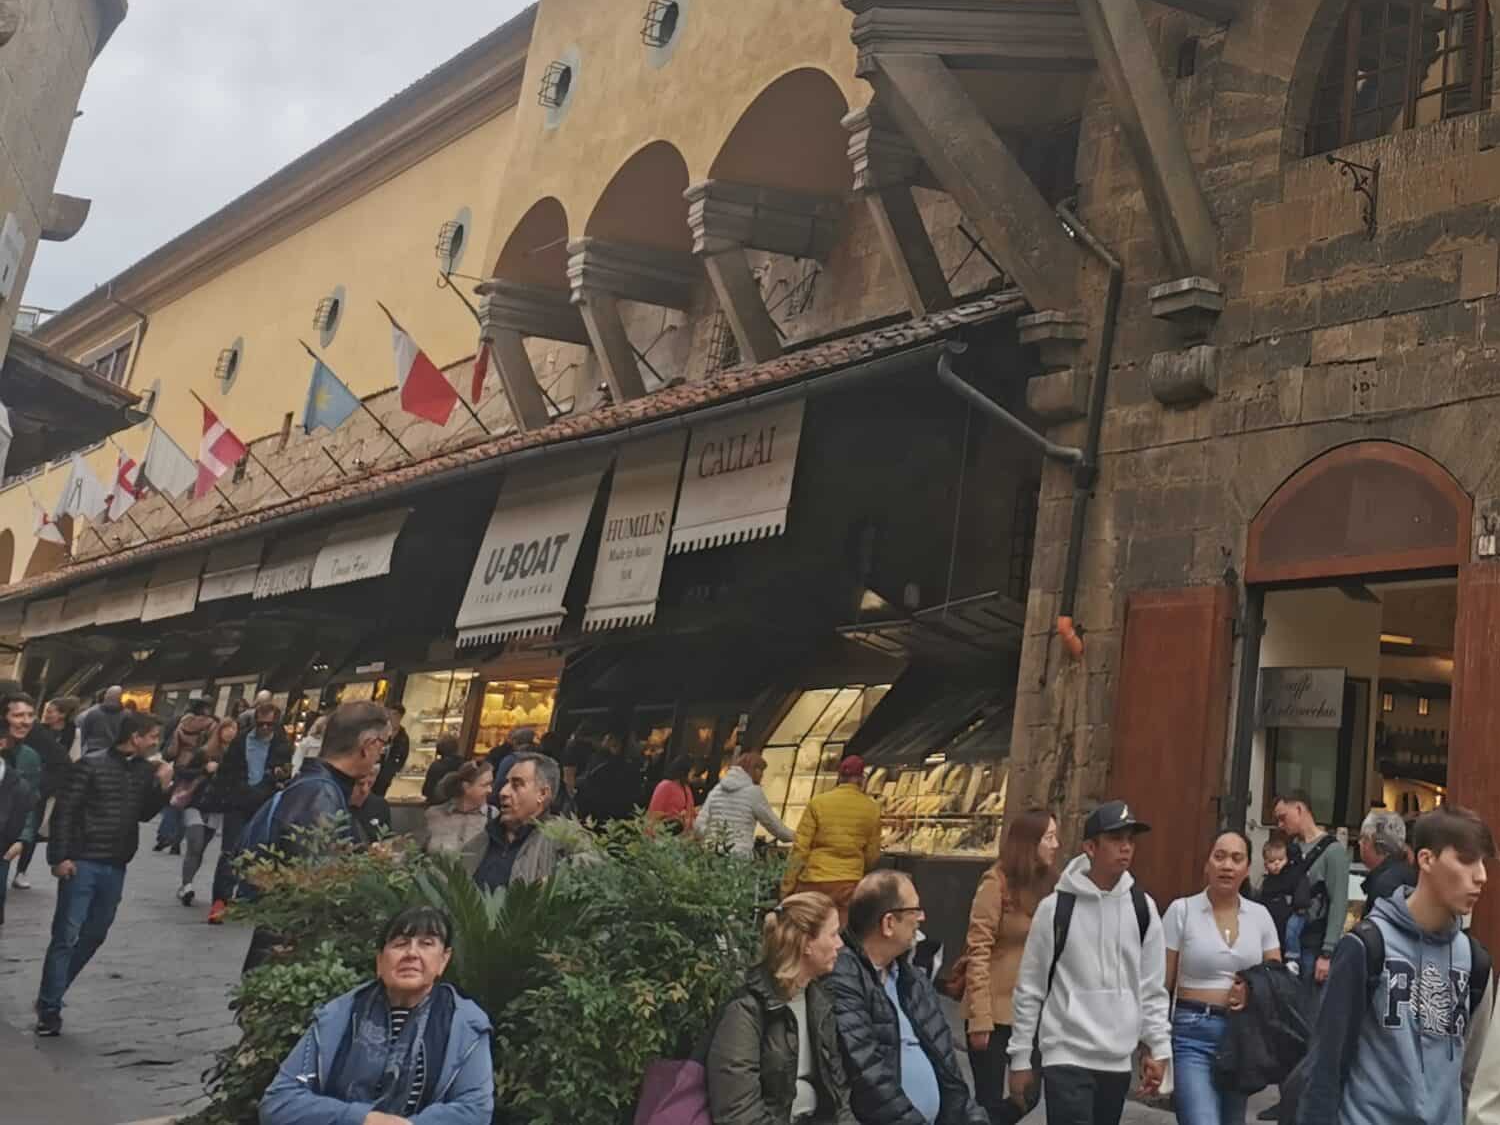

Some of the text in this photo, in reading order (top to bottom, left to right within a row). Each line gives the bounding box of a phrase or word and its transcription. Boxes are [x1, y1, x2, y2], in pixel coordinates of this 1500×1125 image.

[698, 426, 776, 478] CALLAI
[605, 510, 667, 542] HUMILIS
[483, 532, 571, 586] U-BOAT
